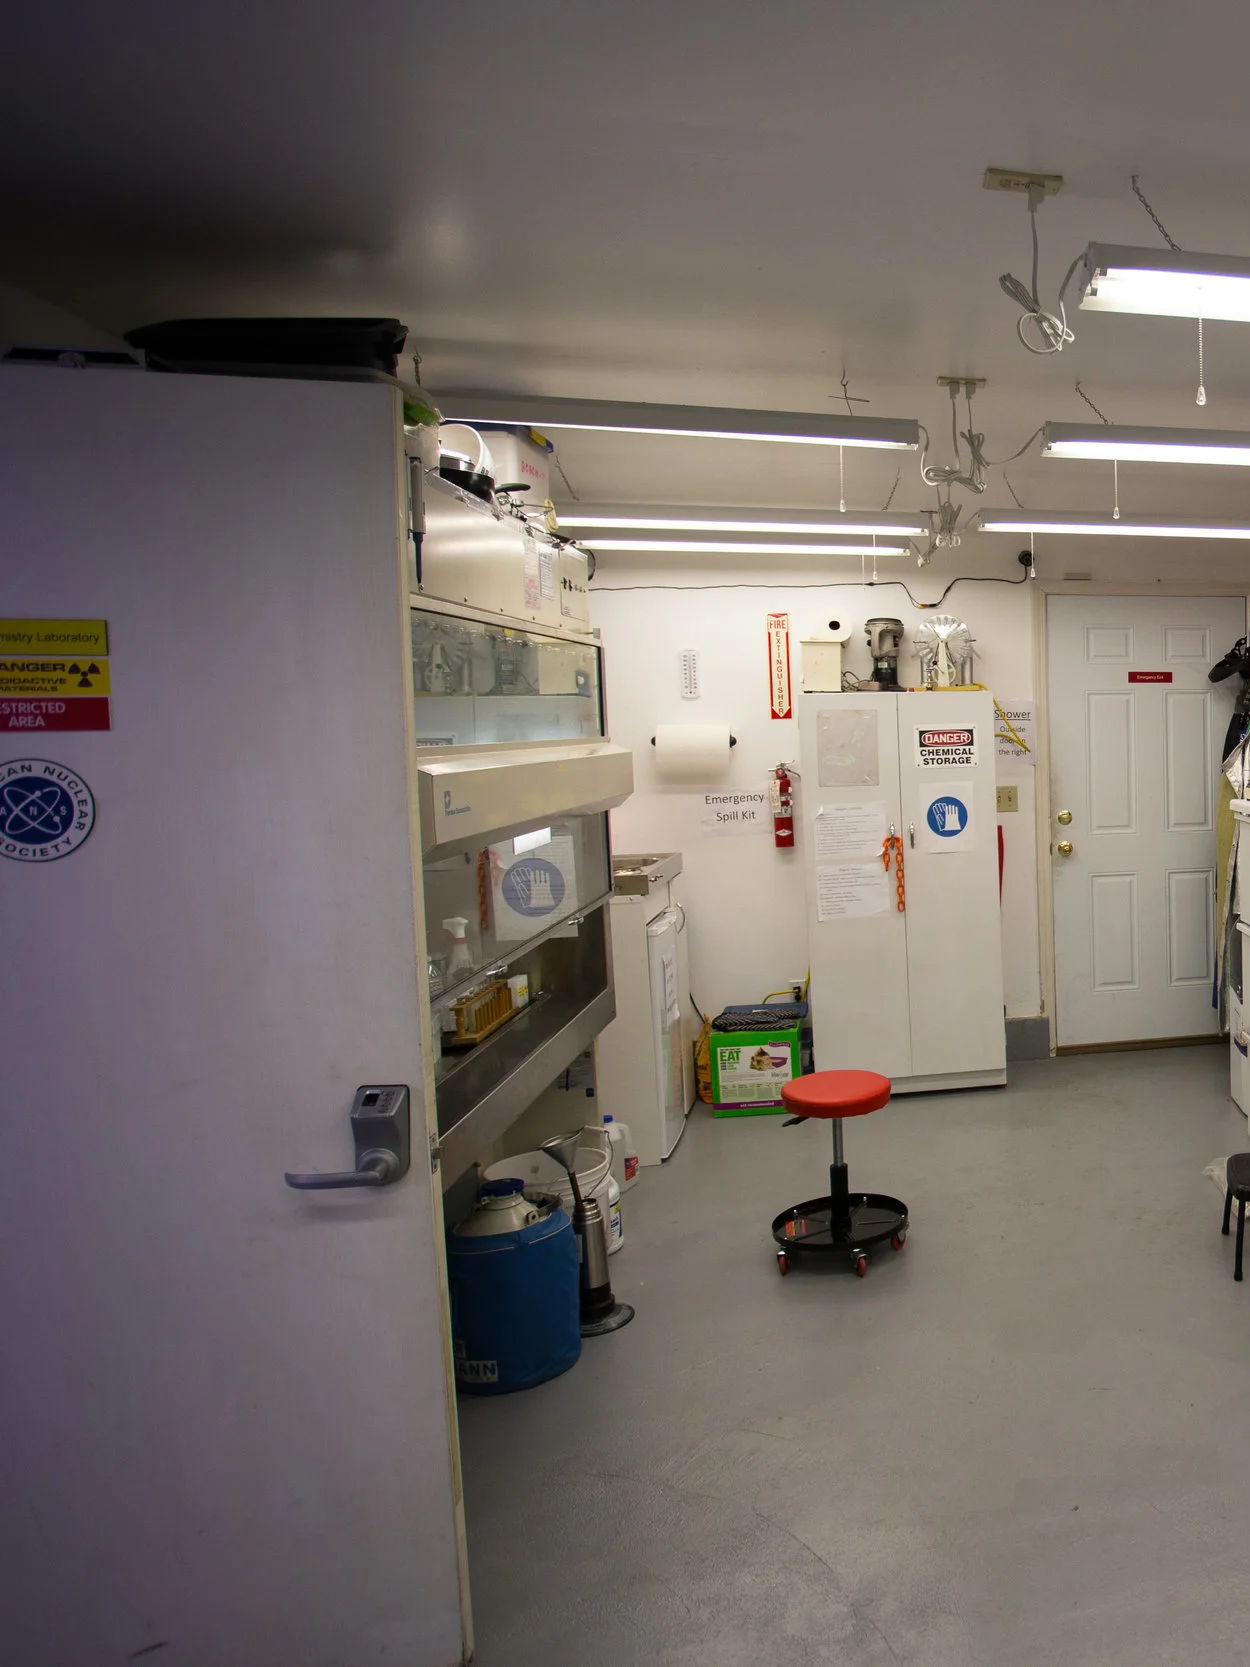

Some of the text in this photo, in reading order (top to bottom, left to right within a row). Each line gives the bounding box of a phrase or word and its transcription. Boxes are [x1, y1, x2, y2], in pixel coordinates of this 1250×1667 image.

[769, 619, 787, 629] FIRE
[37, 632, 100, 645] Laboratory
[775, 631, 784, 714] EXTINGUISHER
[9, 715, 46, 728] AREA
[925, 733, 968, 744] DANGER
[920, 747, 974, 757] CHEMICAL
[999, 748, 1010, 756] the
[923, 757, 972, 766] STORAGE
[43, 766, 89, 832] NUCLEAR
[705, 793, 765, 807] Emergency
[716, 810, 757, 823] Spill Kit
[720, 1050, 741, 1062] EAT
